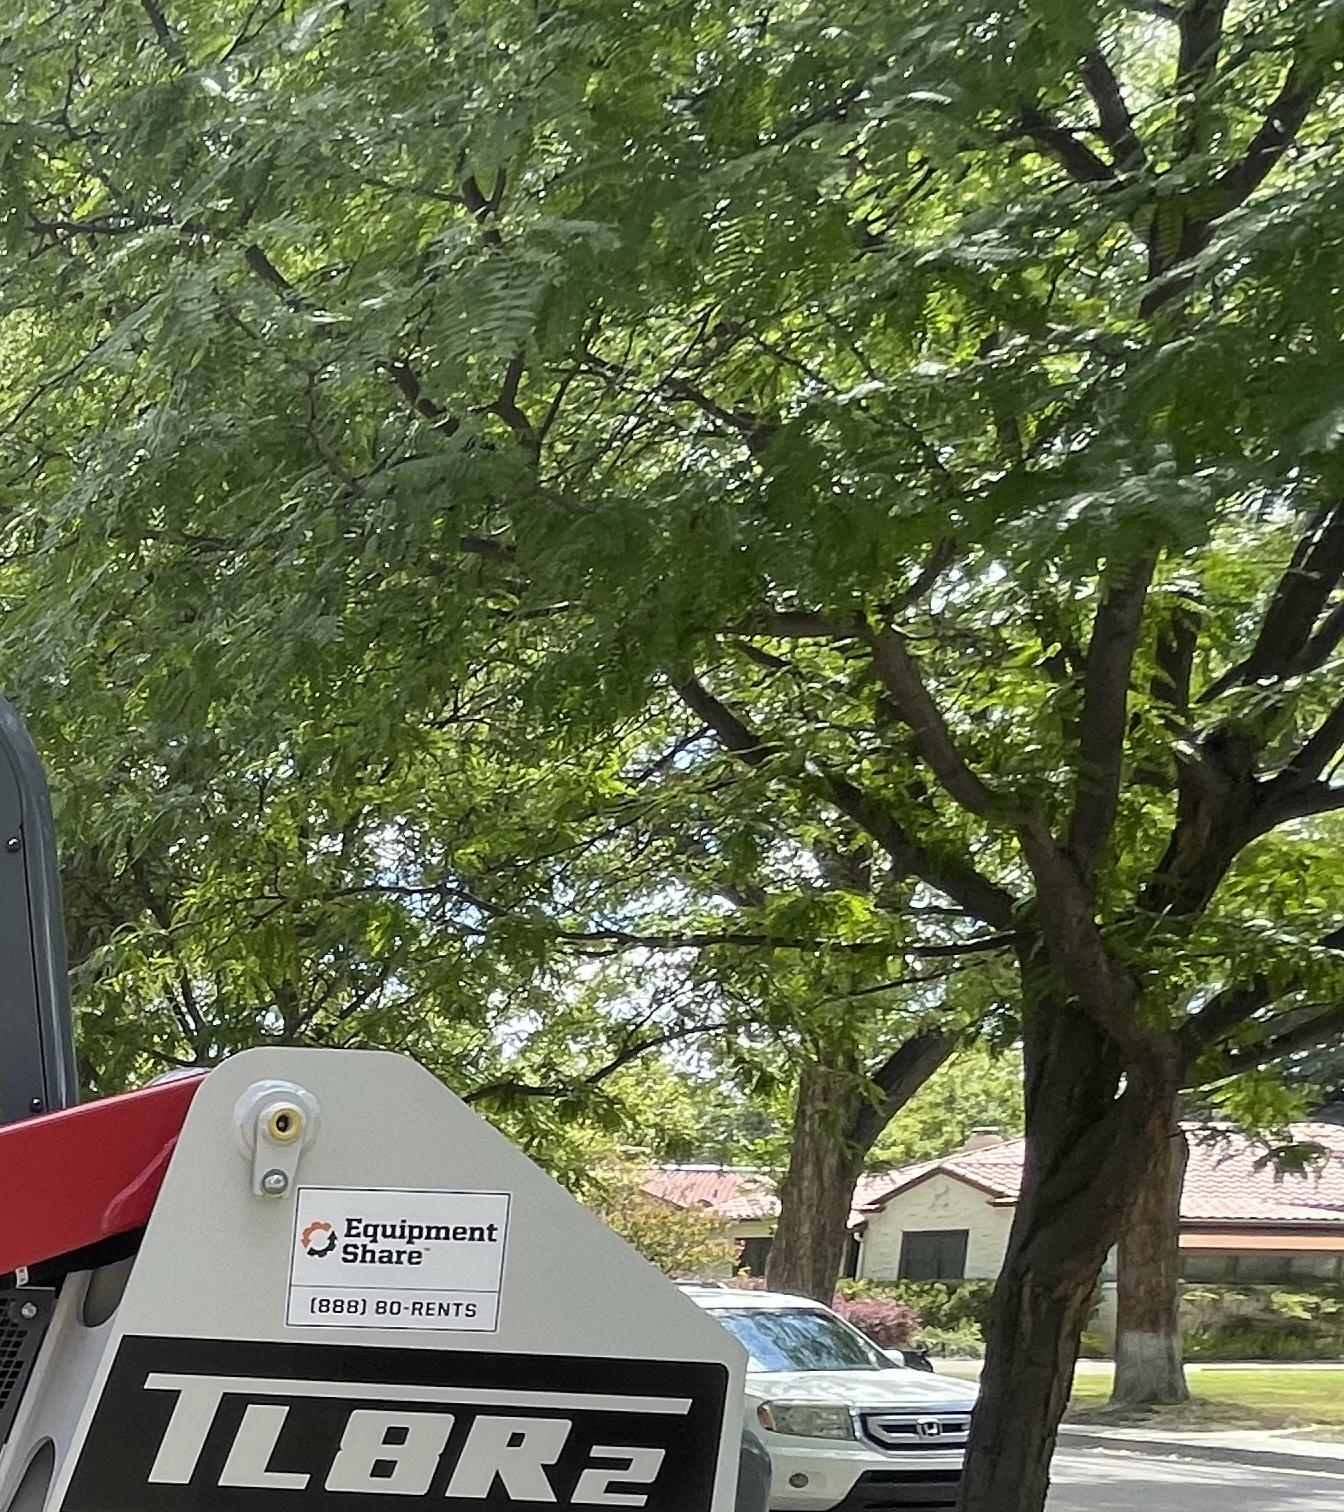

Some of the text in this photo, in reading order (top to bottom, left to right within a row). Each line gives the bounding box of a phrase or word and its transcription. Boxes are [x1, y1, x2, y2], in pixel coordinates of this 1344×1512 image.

[344, 1217, 498, 1244] Equipment
[341, 1243, 423, 1265] Share
[310, 1296, 478, 1319] (888) 80-RENTS
